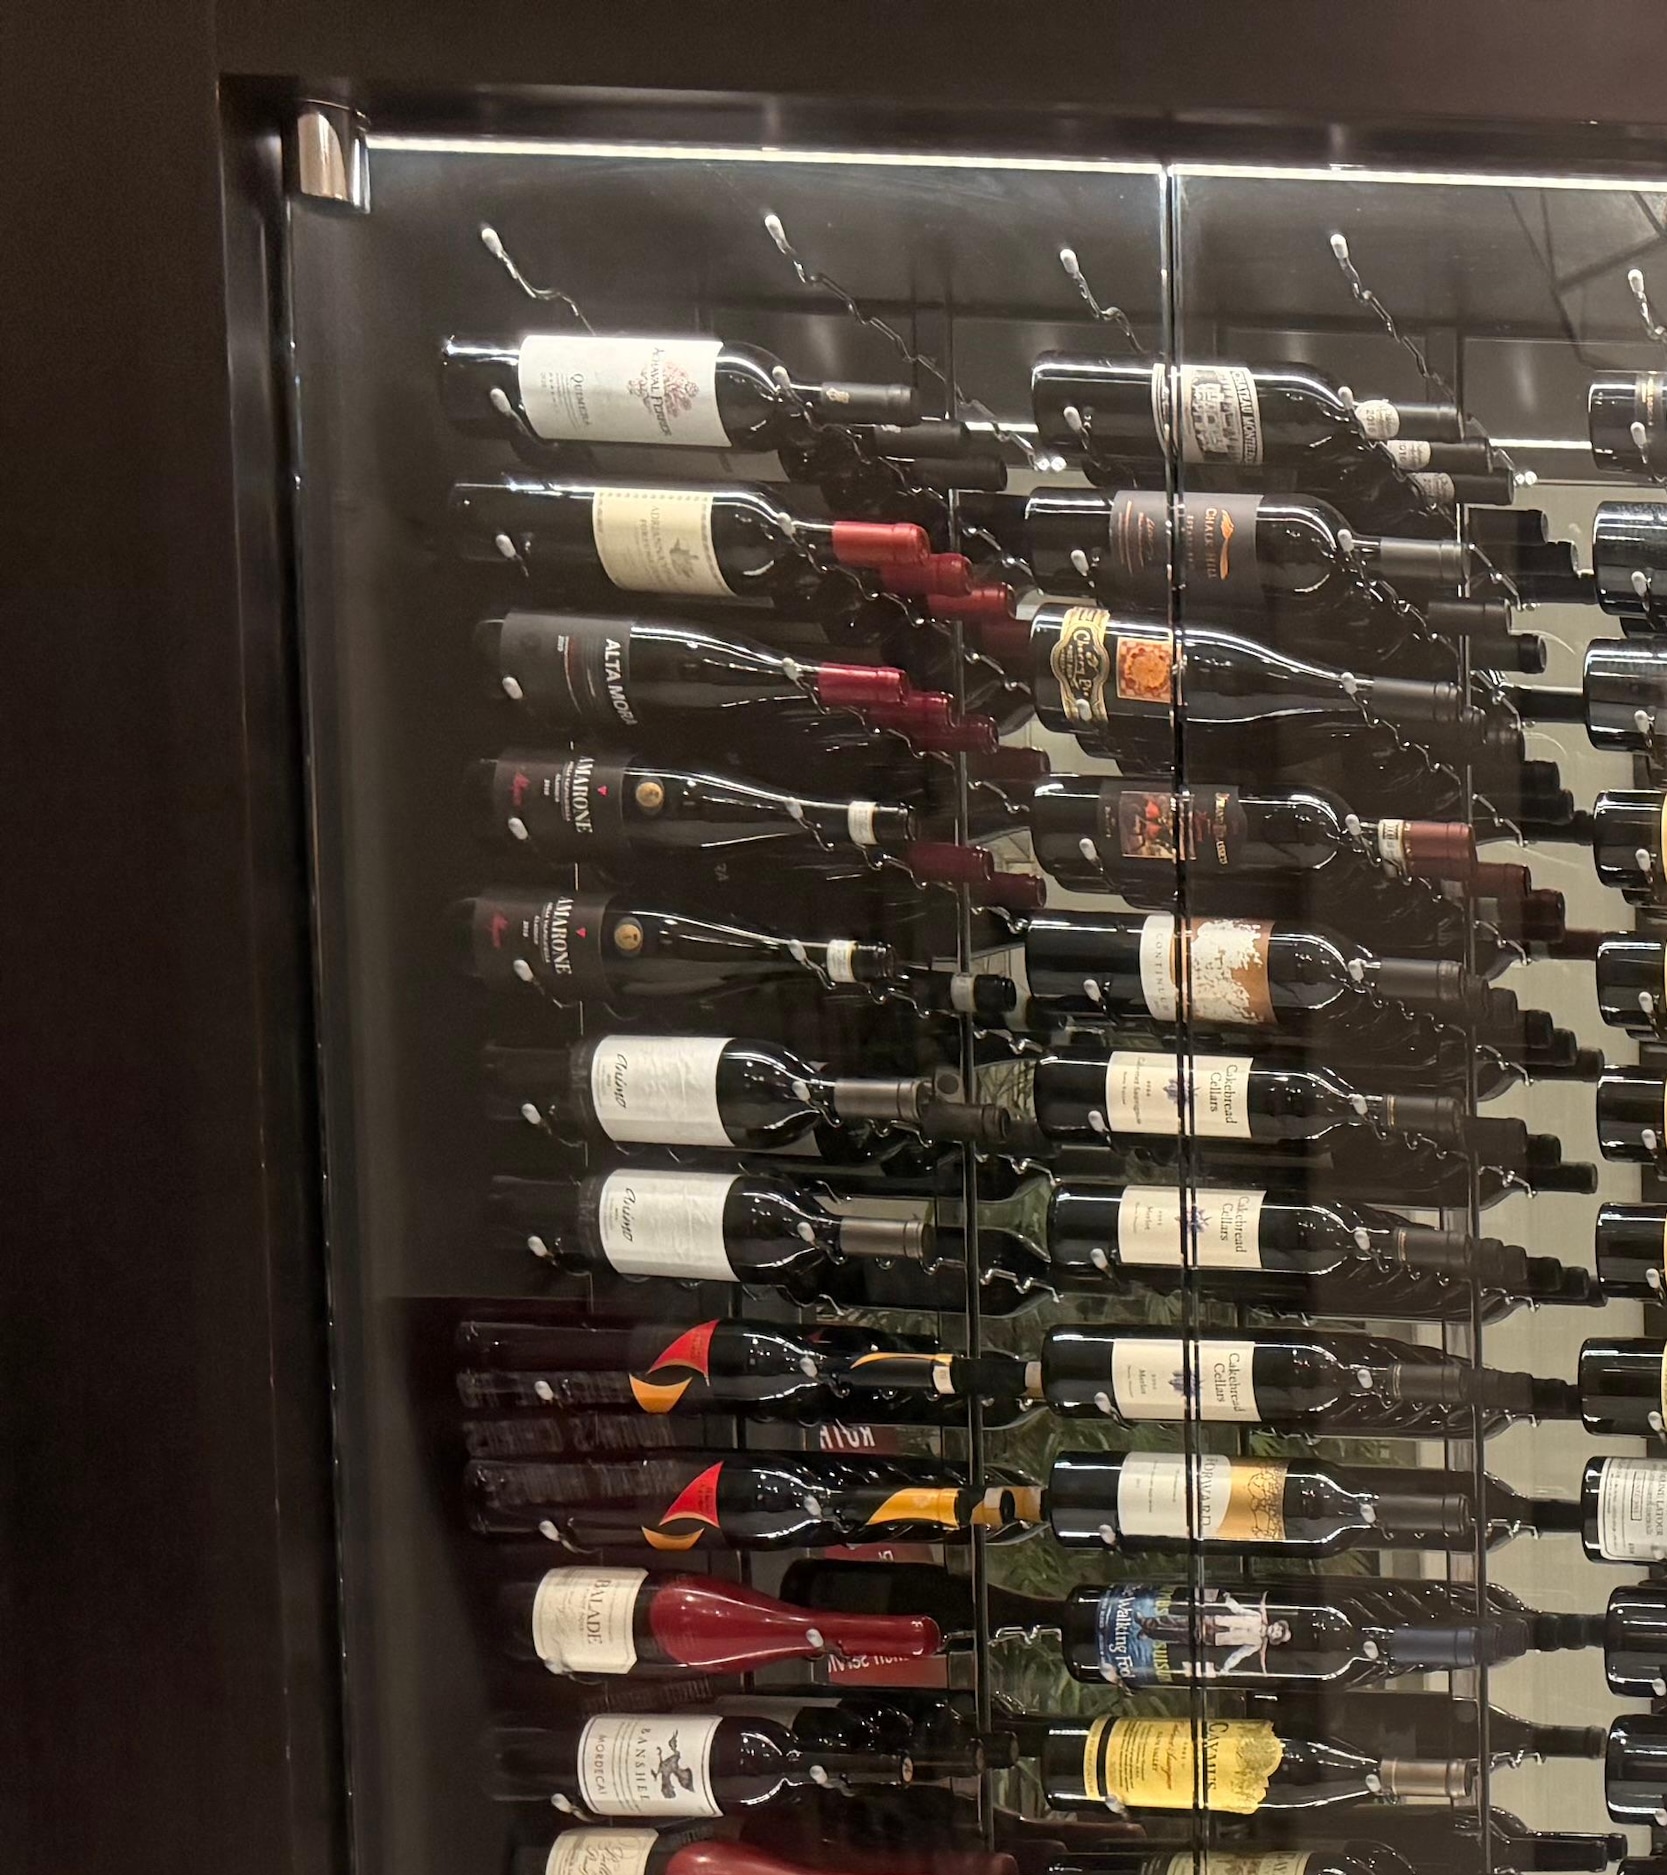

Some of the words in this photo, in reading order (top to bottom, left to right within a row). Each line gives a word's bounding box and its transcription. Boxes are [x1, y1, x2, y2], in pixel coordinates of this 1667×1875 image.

[1232, 371, 1254, 414] CHATEAU
[1204, 508, 1218, 546] CHALK
[1206, 554, 1219, 580] HILL
[605, 640, 621, 681] ALTA
[1072, 630, 1092, 672] Cherry
[608, 684, 637, 725] MORA
[572, 755, 594, 833] AMARONE
[551, 896, 573, 974] AMARONE
[1209, 1072, 1223, 1113] Cellars
[1220, 1064, 1239, 1124] Cakebread
[1219, 1203, 1236, 1242] Cellars
[1229, 1196, 1250, 1253] Cakebread
[1212, 1362, 1230, 1404] Cellars
[1226, 1352, 1245, 1412] Cakebread
[1654, 1506, 1666, 1536] LATOUR
[586, 1579, 609, 1644] BALADE
[1114, 1598, 1137, 1653] Walking
[594, 1734, 609, 1796] MORDECAI
[1204, 1722, 1230, 1792] CAYMUS
